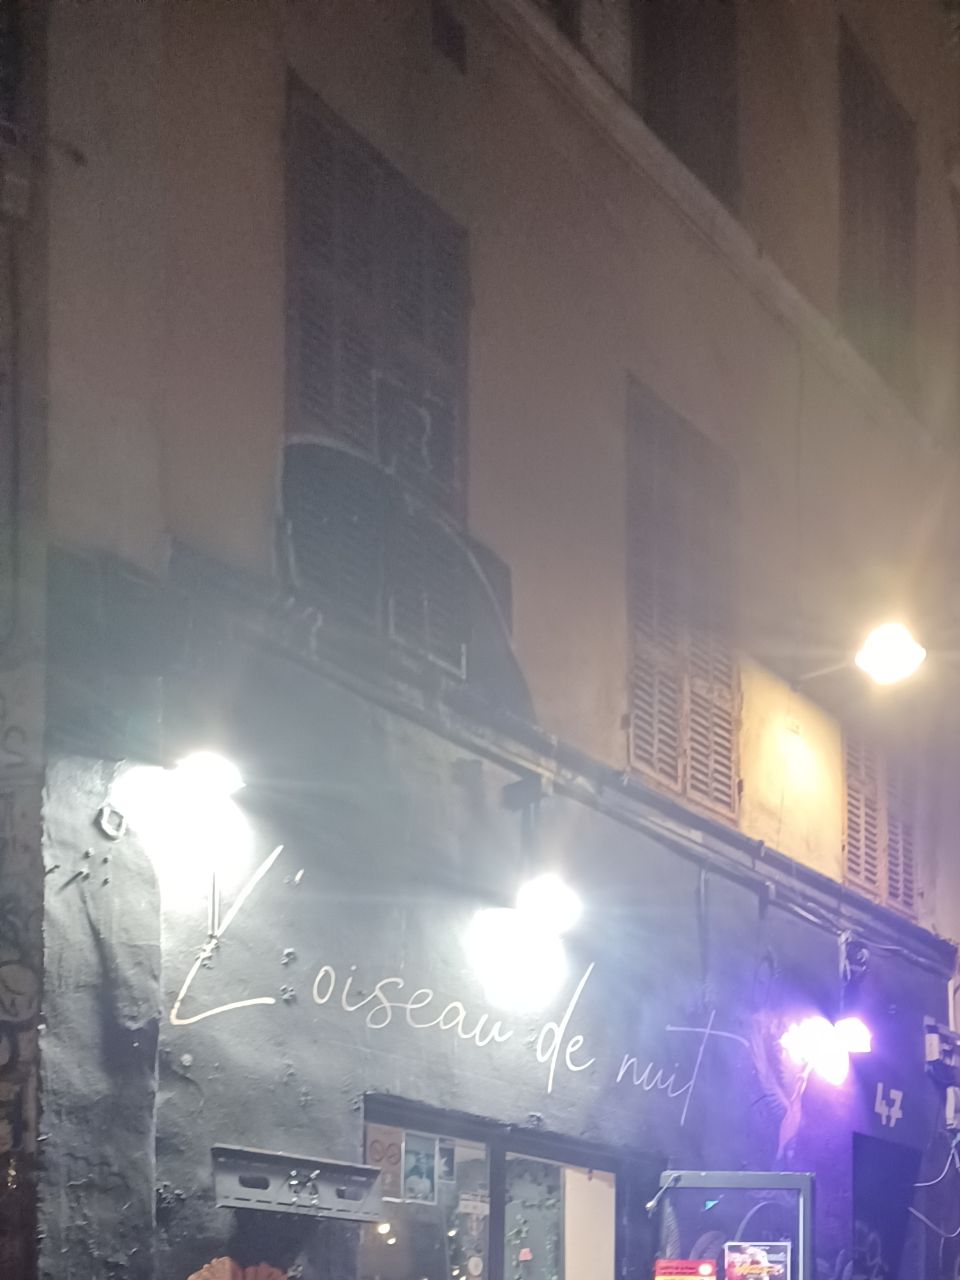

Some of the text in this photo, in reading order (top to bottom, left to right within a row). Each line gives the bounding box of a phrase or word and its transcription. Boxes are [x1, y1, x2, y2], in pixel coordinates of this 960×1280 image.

[536, 961, 596, 1094] de
[616, 1009, 751, 1127] nuit
[874, 1082, 903, 1128] 47
